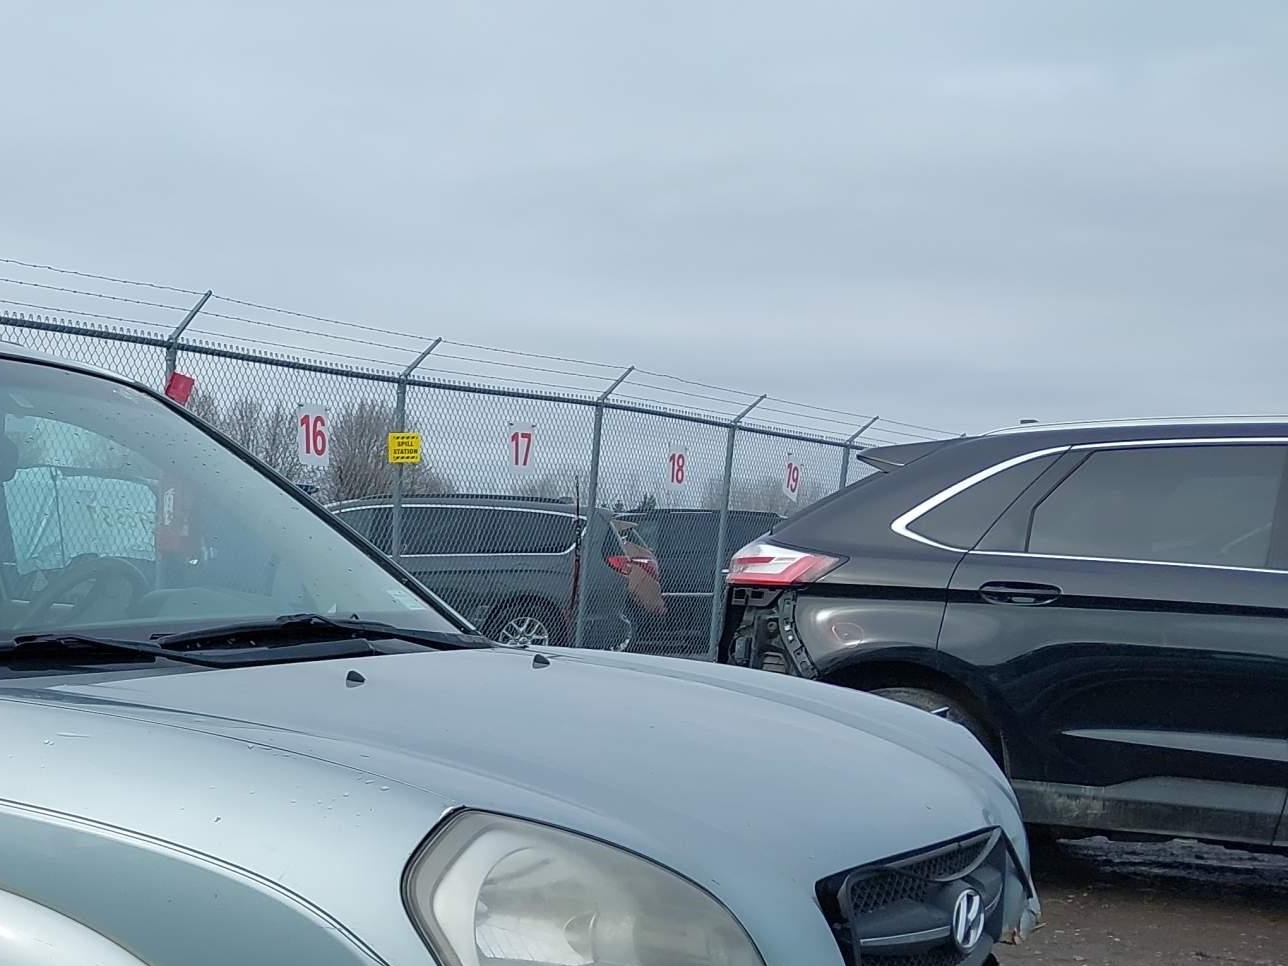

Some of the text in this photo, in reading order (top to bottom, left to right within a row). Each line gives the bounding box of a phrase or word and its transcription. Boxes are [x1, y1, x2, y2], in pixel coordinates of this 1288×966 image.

[300, 414, 327, 456] 16
[510, 431, 532, 466] 17
[668, 453, 685, 485] 18
[787, 462, 800, 493] 19
